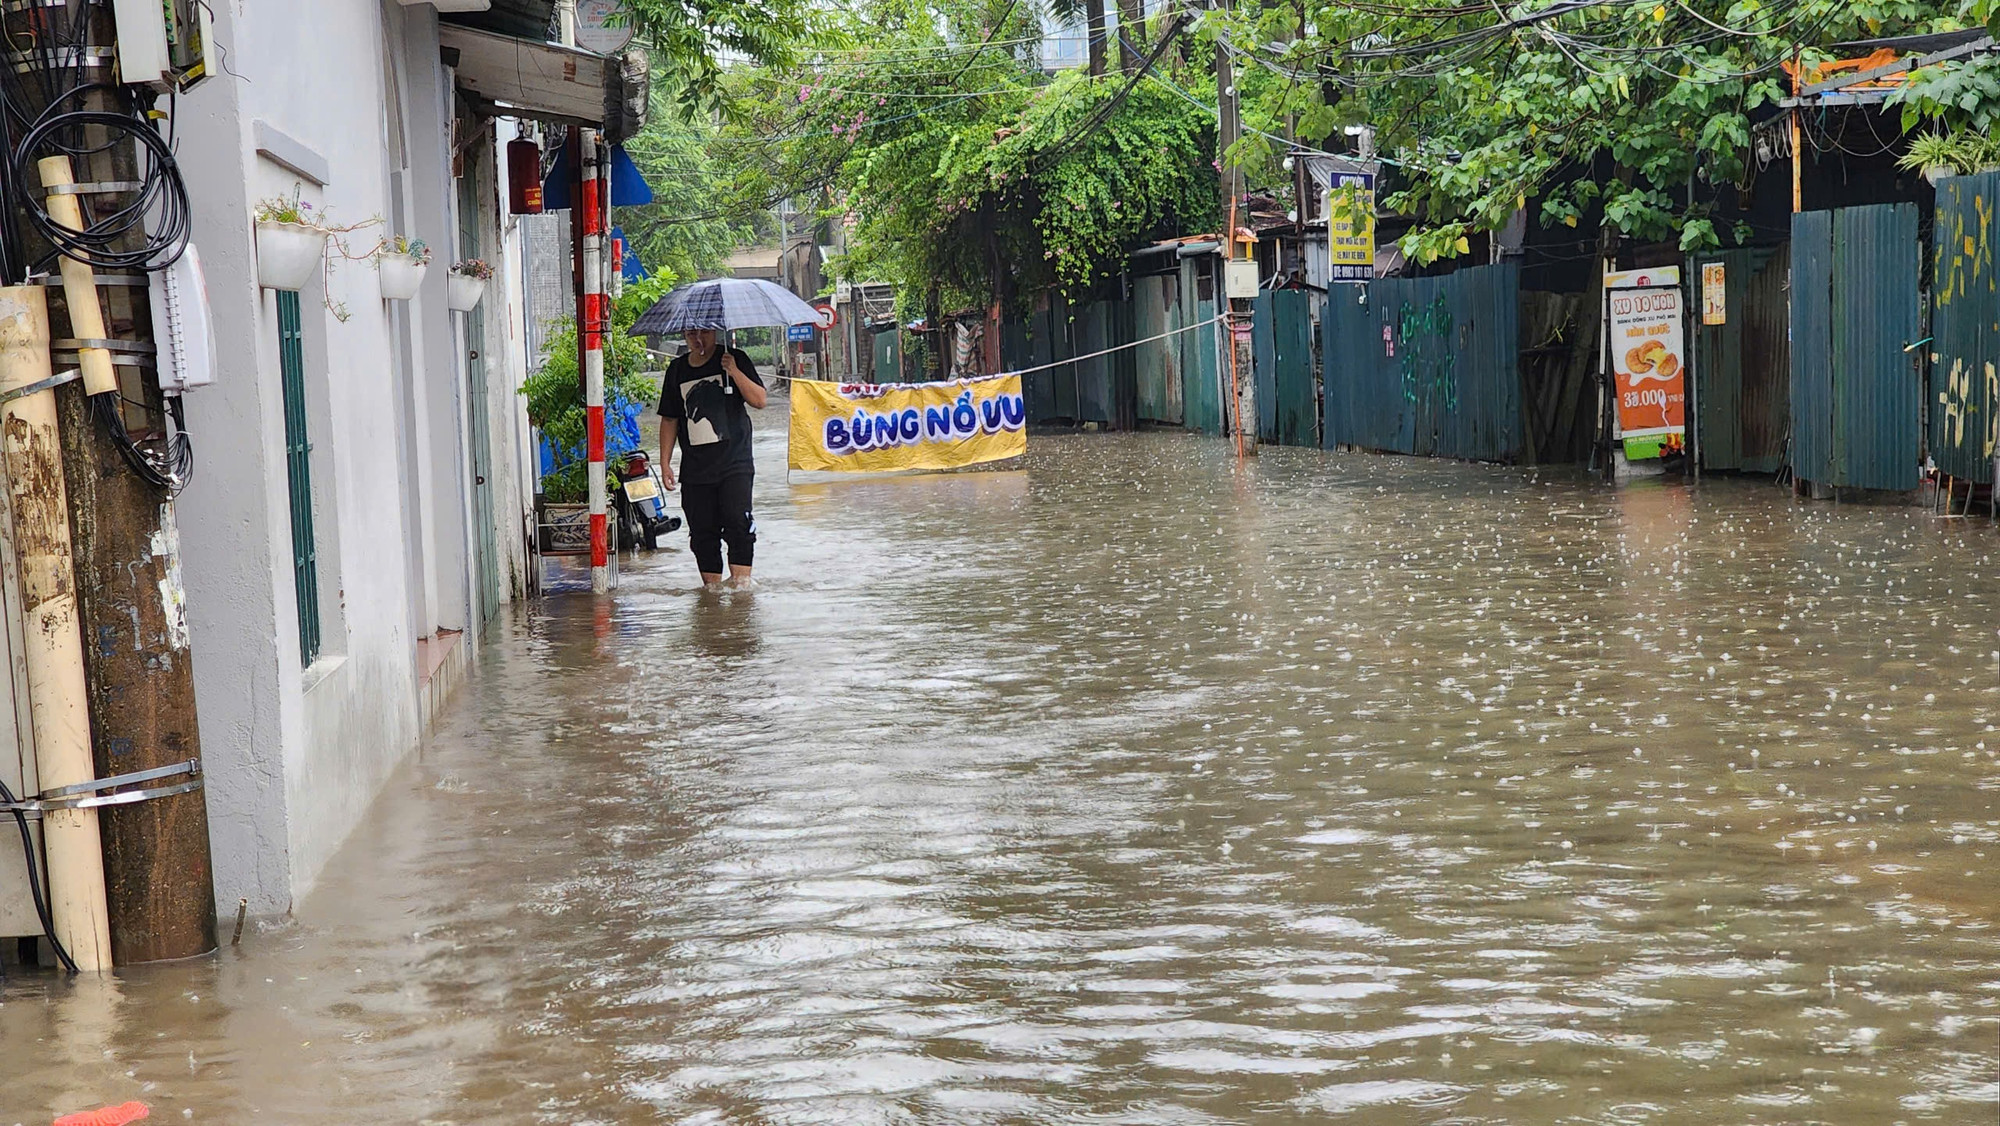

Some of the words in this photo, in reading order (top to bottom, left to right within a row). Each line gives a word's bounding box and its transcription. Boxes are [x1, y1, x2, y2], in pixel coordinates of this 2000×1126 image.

[1614, 298, 1631, 315] XU
[1634, 296, 1651, 313] 10
[1652, 293, 1676, 311] WON
[826, 408, 919, 450] BÙNG
[926, 390, 976, 437] NỔ
